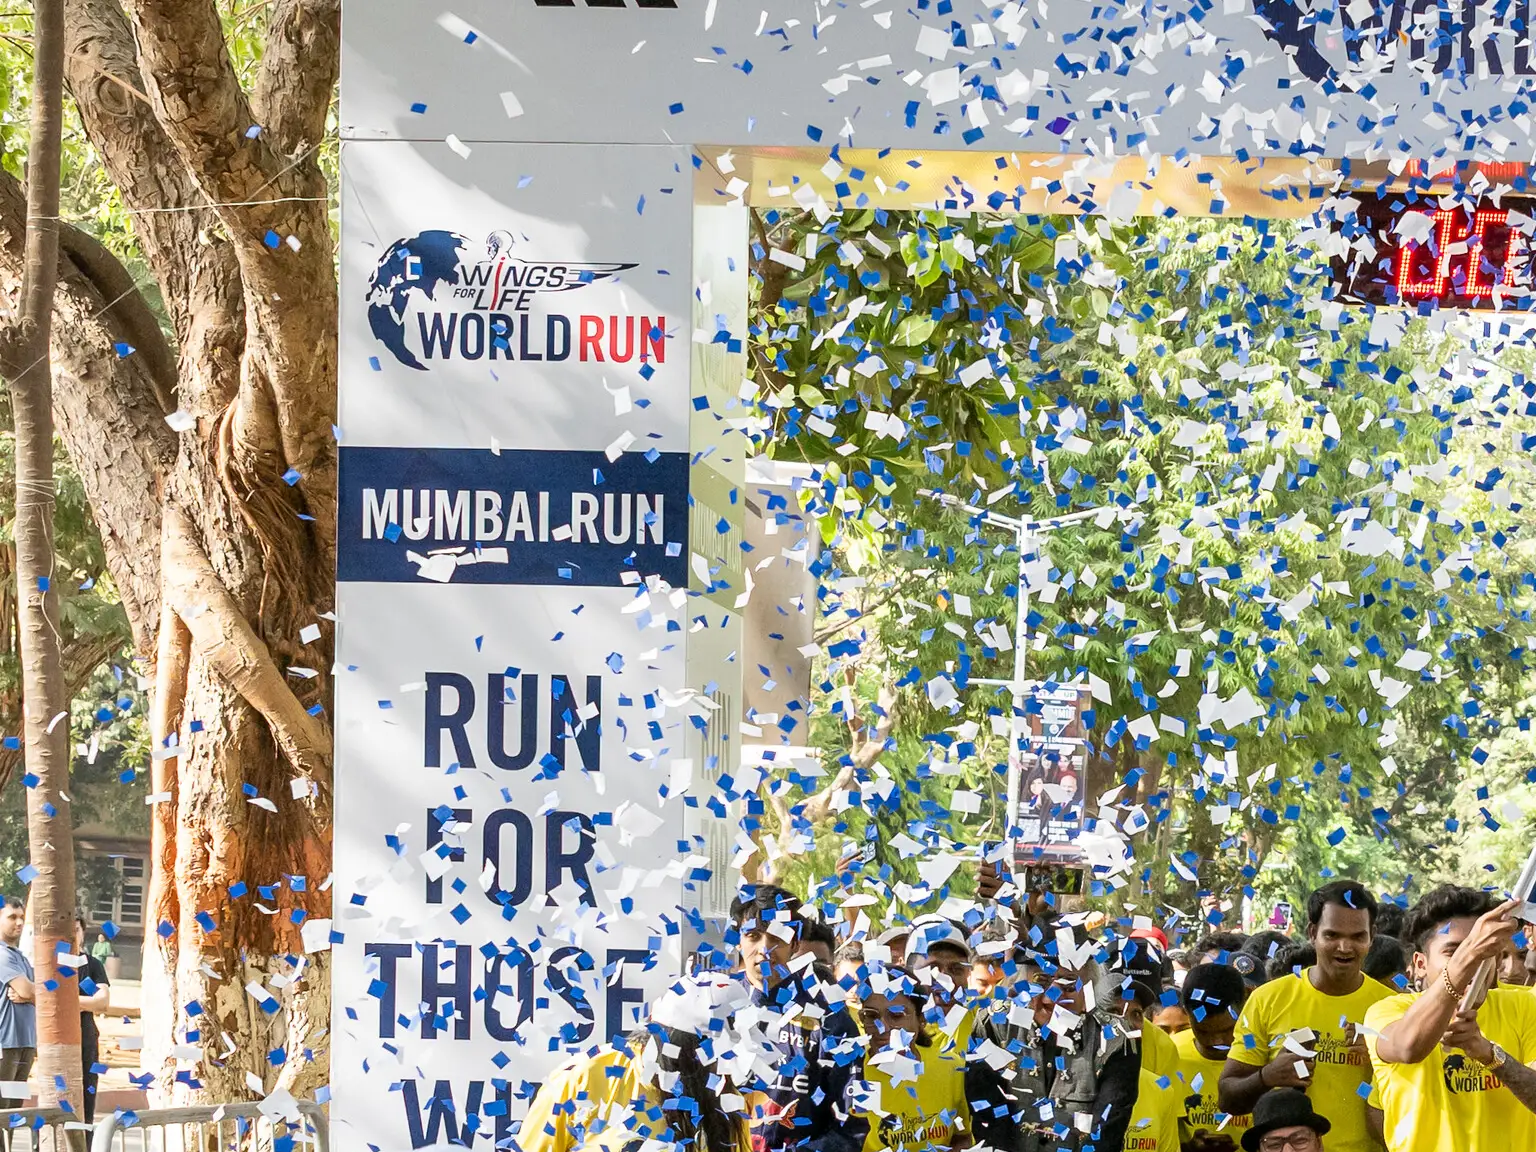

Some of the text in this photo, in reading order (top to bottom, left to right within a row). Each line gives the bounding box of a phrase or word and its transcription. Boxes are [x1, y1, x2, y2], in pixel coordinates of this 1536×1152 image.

[453, 288, 476, 299] FOR
[461, 262, 567, 288] WINGS
[473, 289, 536, 311] LIFE
[417, 312, 666, 364] WORLD RUN
[362, 488, 551, 542] MUMBAI
[571, 491, 664, 545] RUN
[424, 671, 601, 771] RUN
[425, 808, 597, 908] FOR
[364, 943, 655, 1045] THOSE
[1138, 1138, 1157, 1150] RUN
